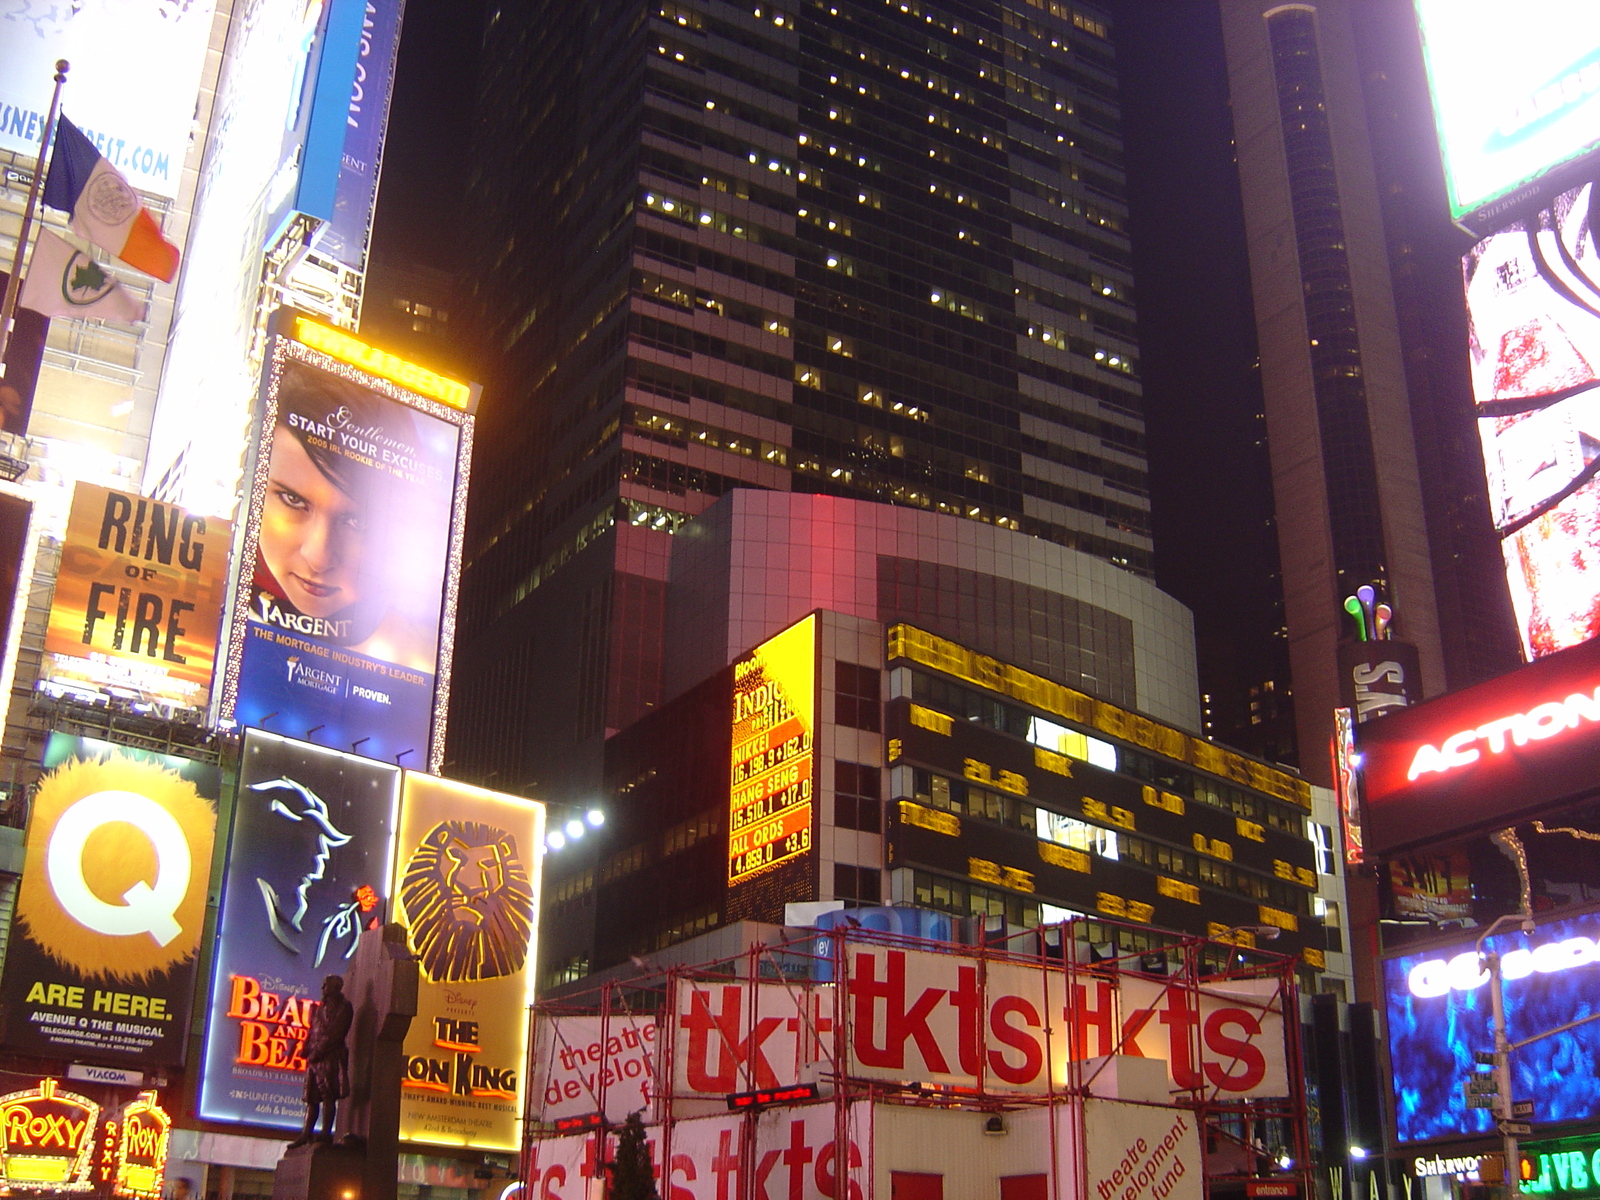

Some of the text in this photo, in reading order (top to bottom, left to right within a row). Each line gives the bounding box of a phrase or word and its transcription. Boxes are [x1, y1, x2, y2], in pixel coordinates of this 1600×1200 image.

[1478, 186, 1540, 222] SHERWOOD
[288, 413, 447, 483] START YOUR EXCUSES.
[307, 435, 327, 449] 2005
[329, 443, 342, 455] IRL
[344, 448, 373, 467] ROOKIE
[375, 461, 385, 471] OF
[98, 491, 206, 572] RING
[125, 565, 157, 581] OF
[82, 582, 195, 665] FIRE
[269, 605, 352, 637] ARGENT
[253, 627, 427, 686] THE MORTGAGE INDUSTRY'S LEADER.
[296, 663, 342, 687] ARGENT
[297, 677, 336, 695] MORTGAGE
[352, 686, 392, 705] PROVEN.
[734, 733, 769, 763] NIKKEI
[733, 766, 799, 809] HANG SENG
[732, 820, 784, 856] ALL ORDS
[786, 828, 809, 852] +3.6
[47, 790, 192, 948] Q
[25, 981, 173, 1021] ARE HERE.
[443, 988, 478, 1010] Disney
[30, 1011, 164, 1037] AVENUE Q THE MUSICAL
[40, 1026, 101, 1040] TELECHARGE.COM
[274, 1025, 308, 1041] AND
[433, 1016, 479, 1045] THE
[847, 950, 1043, 1085] tkts
[559, 1023, 656, 1071] theatre
[1064, 981, 1266, 1092] tkts
[86, 1068, 127, 1082] VIACOM
[453, 1052, 517, 1097] KING
[408, 1112, 493, 1129] NEW AMSTERDAM THEATRE
[478, 1102, 491, 1110] BEST
[493, 1104, 517, 1113] MUSICAL
[4, 1105, 86, 1149] ROXY
[128, 1116, 163, 1158] ROXY
[423, 1124, 440, 1133] 42nd
[448, 1127, 478, 1138] Broadway
[101, 1121, 117, 1181] ROXY
[711, 1120, 863, 1200] tkts
[1097, 1136, 1148, 1200] theatre
[1415, 1153, 1493, 1177] SHERWO
[1152, 1154, 1186, 1200] fund
[1256, 1184, 1289, 1196] entrance
